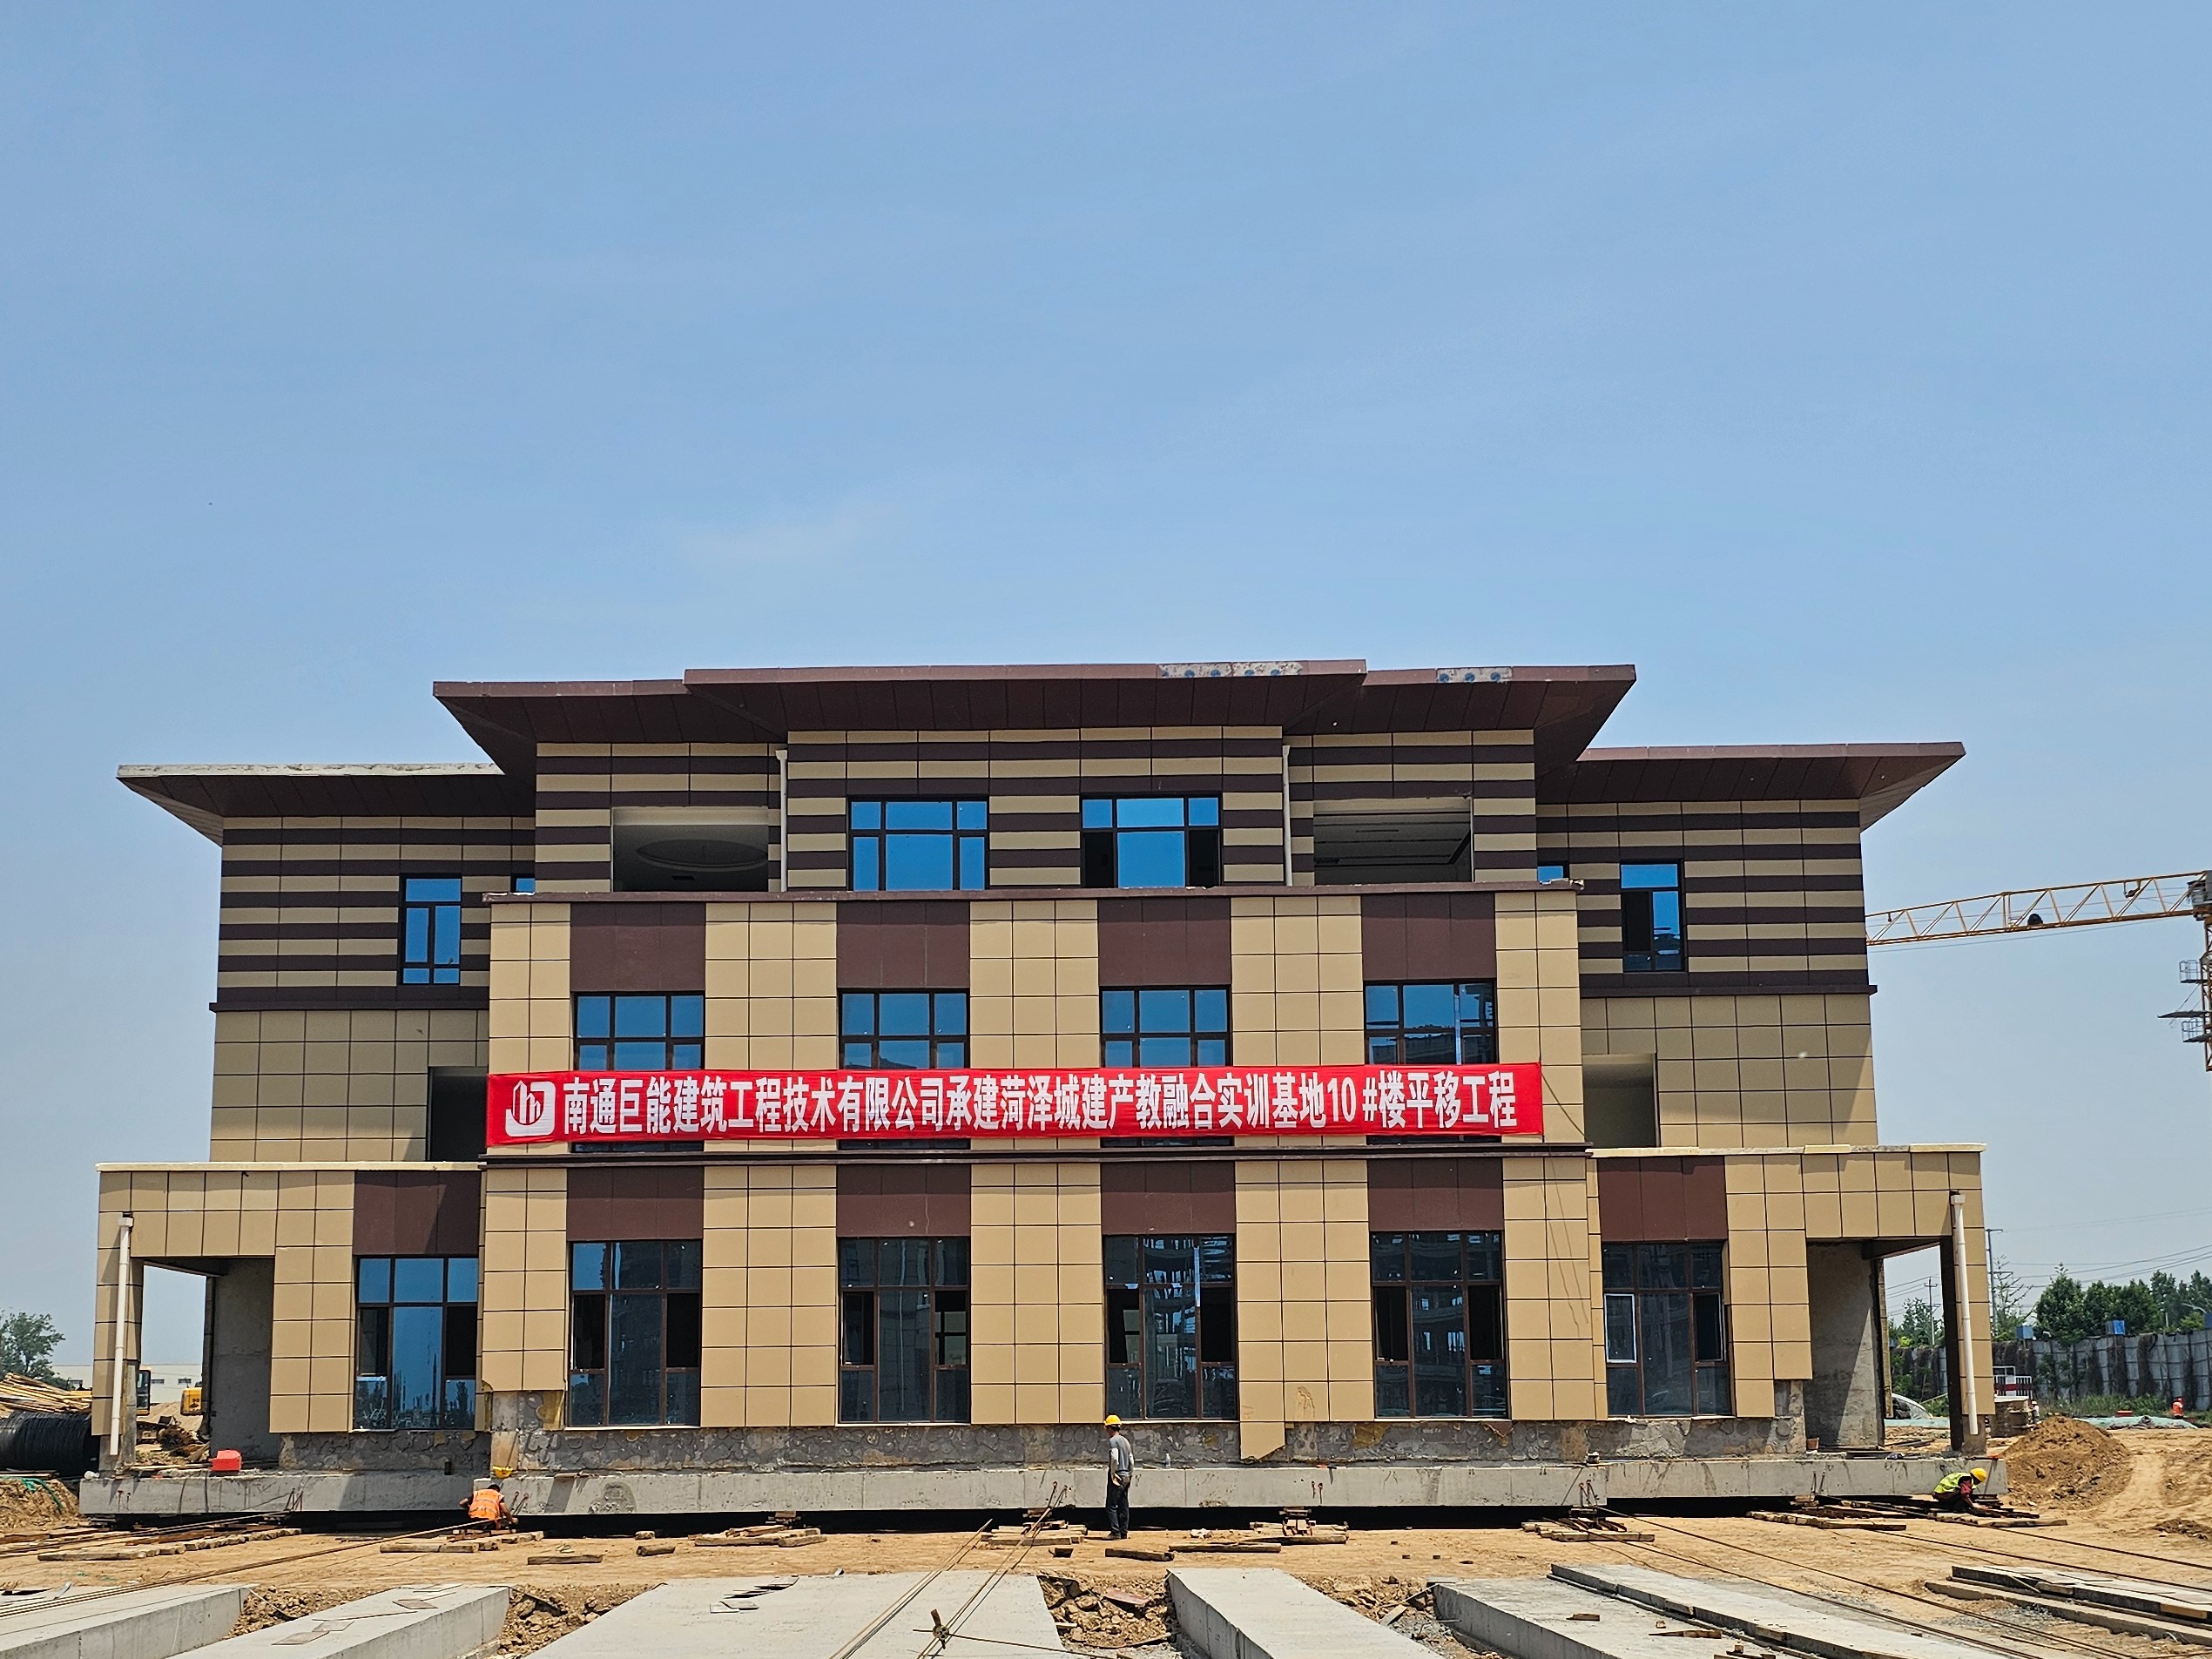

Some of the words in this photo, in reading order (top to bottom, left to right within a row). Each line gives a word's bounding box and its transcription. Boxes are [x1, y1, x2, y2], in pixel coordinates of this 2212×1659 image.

[563, 1069, 1517, 1135] 南通巨能建筑工程技术有限公司承建菏泽城建产教融合实训基地10#楼平移工程
